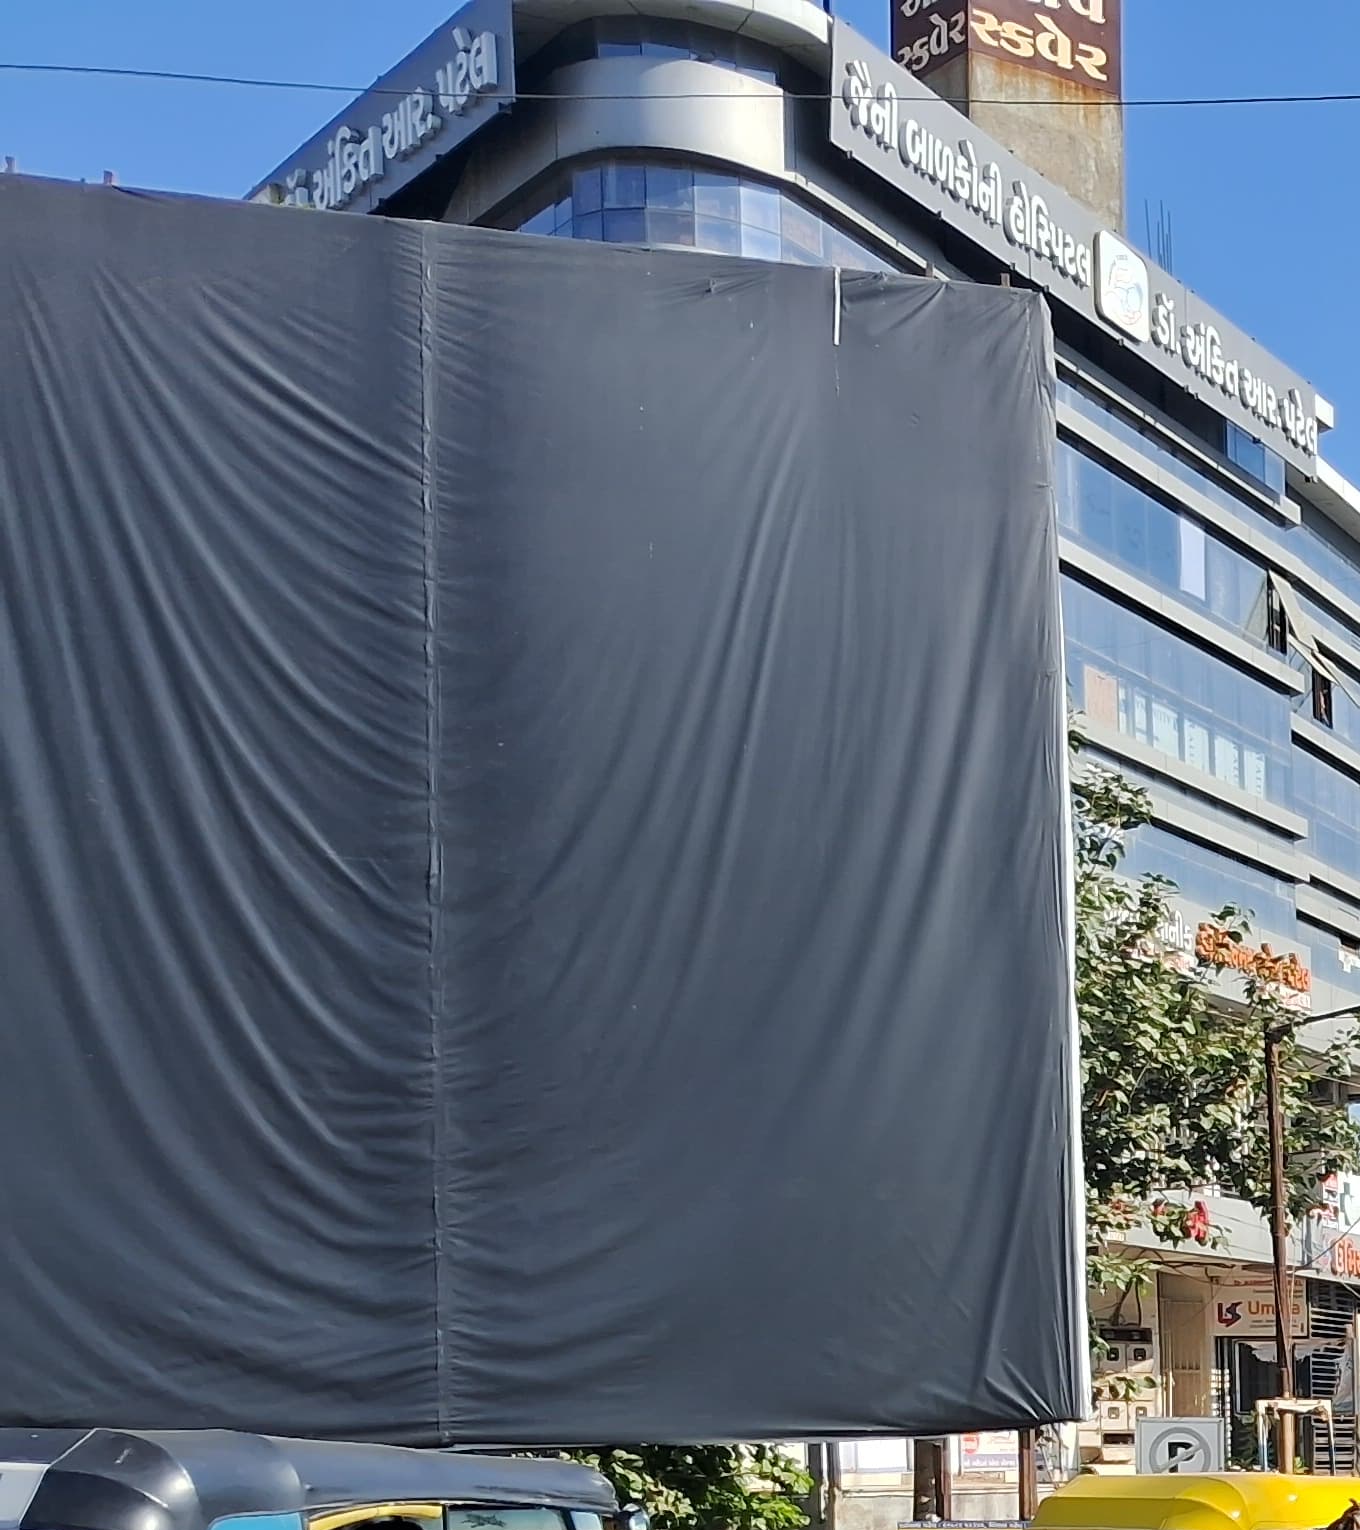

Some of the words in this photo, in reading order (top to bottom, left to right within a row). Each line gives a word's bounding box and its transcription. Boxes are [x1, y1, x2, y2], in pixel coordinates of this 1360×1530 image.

[314, 125, 383, 210] અંકિત
[436, 26, 498, 114] પટેલ
[903, 119, 1001, 226] બાળકોની
[1006, 180, 1091, 287] હોસ્પિટલ
[1185, 322, 1240, 398] અંકિત
[1282, 388, 1318, 455] પટેલ
[1248, 1300, 1301, 1316] Uma
